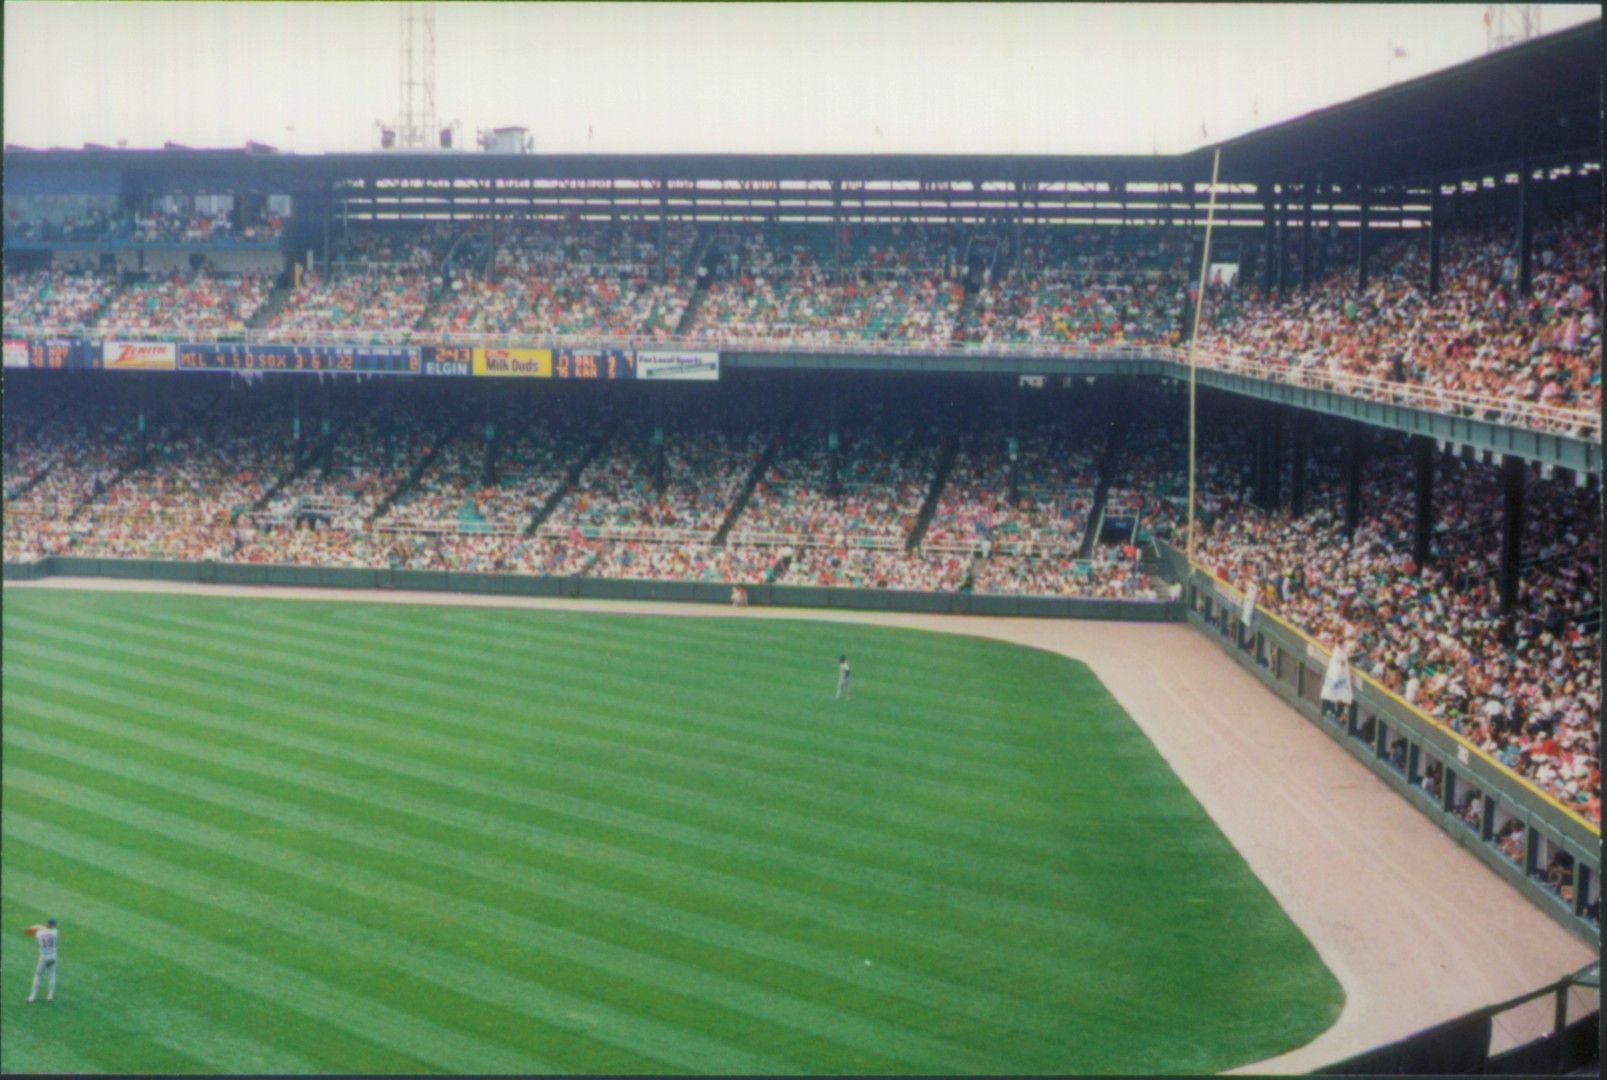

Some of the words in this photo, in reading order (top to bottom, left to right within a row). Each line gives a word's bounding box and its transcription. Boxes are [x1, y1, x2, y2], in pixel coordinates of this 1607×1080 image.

[259, 353, 286, 368] SOX
[485, 358, 509, 372] Milk
[511, 360, 539, 373] Duds
[426, 362, 467, 375] ELGIN
